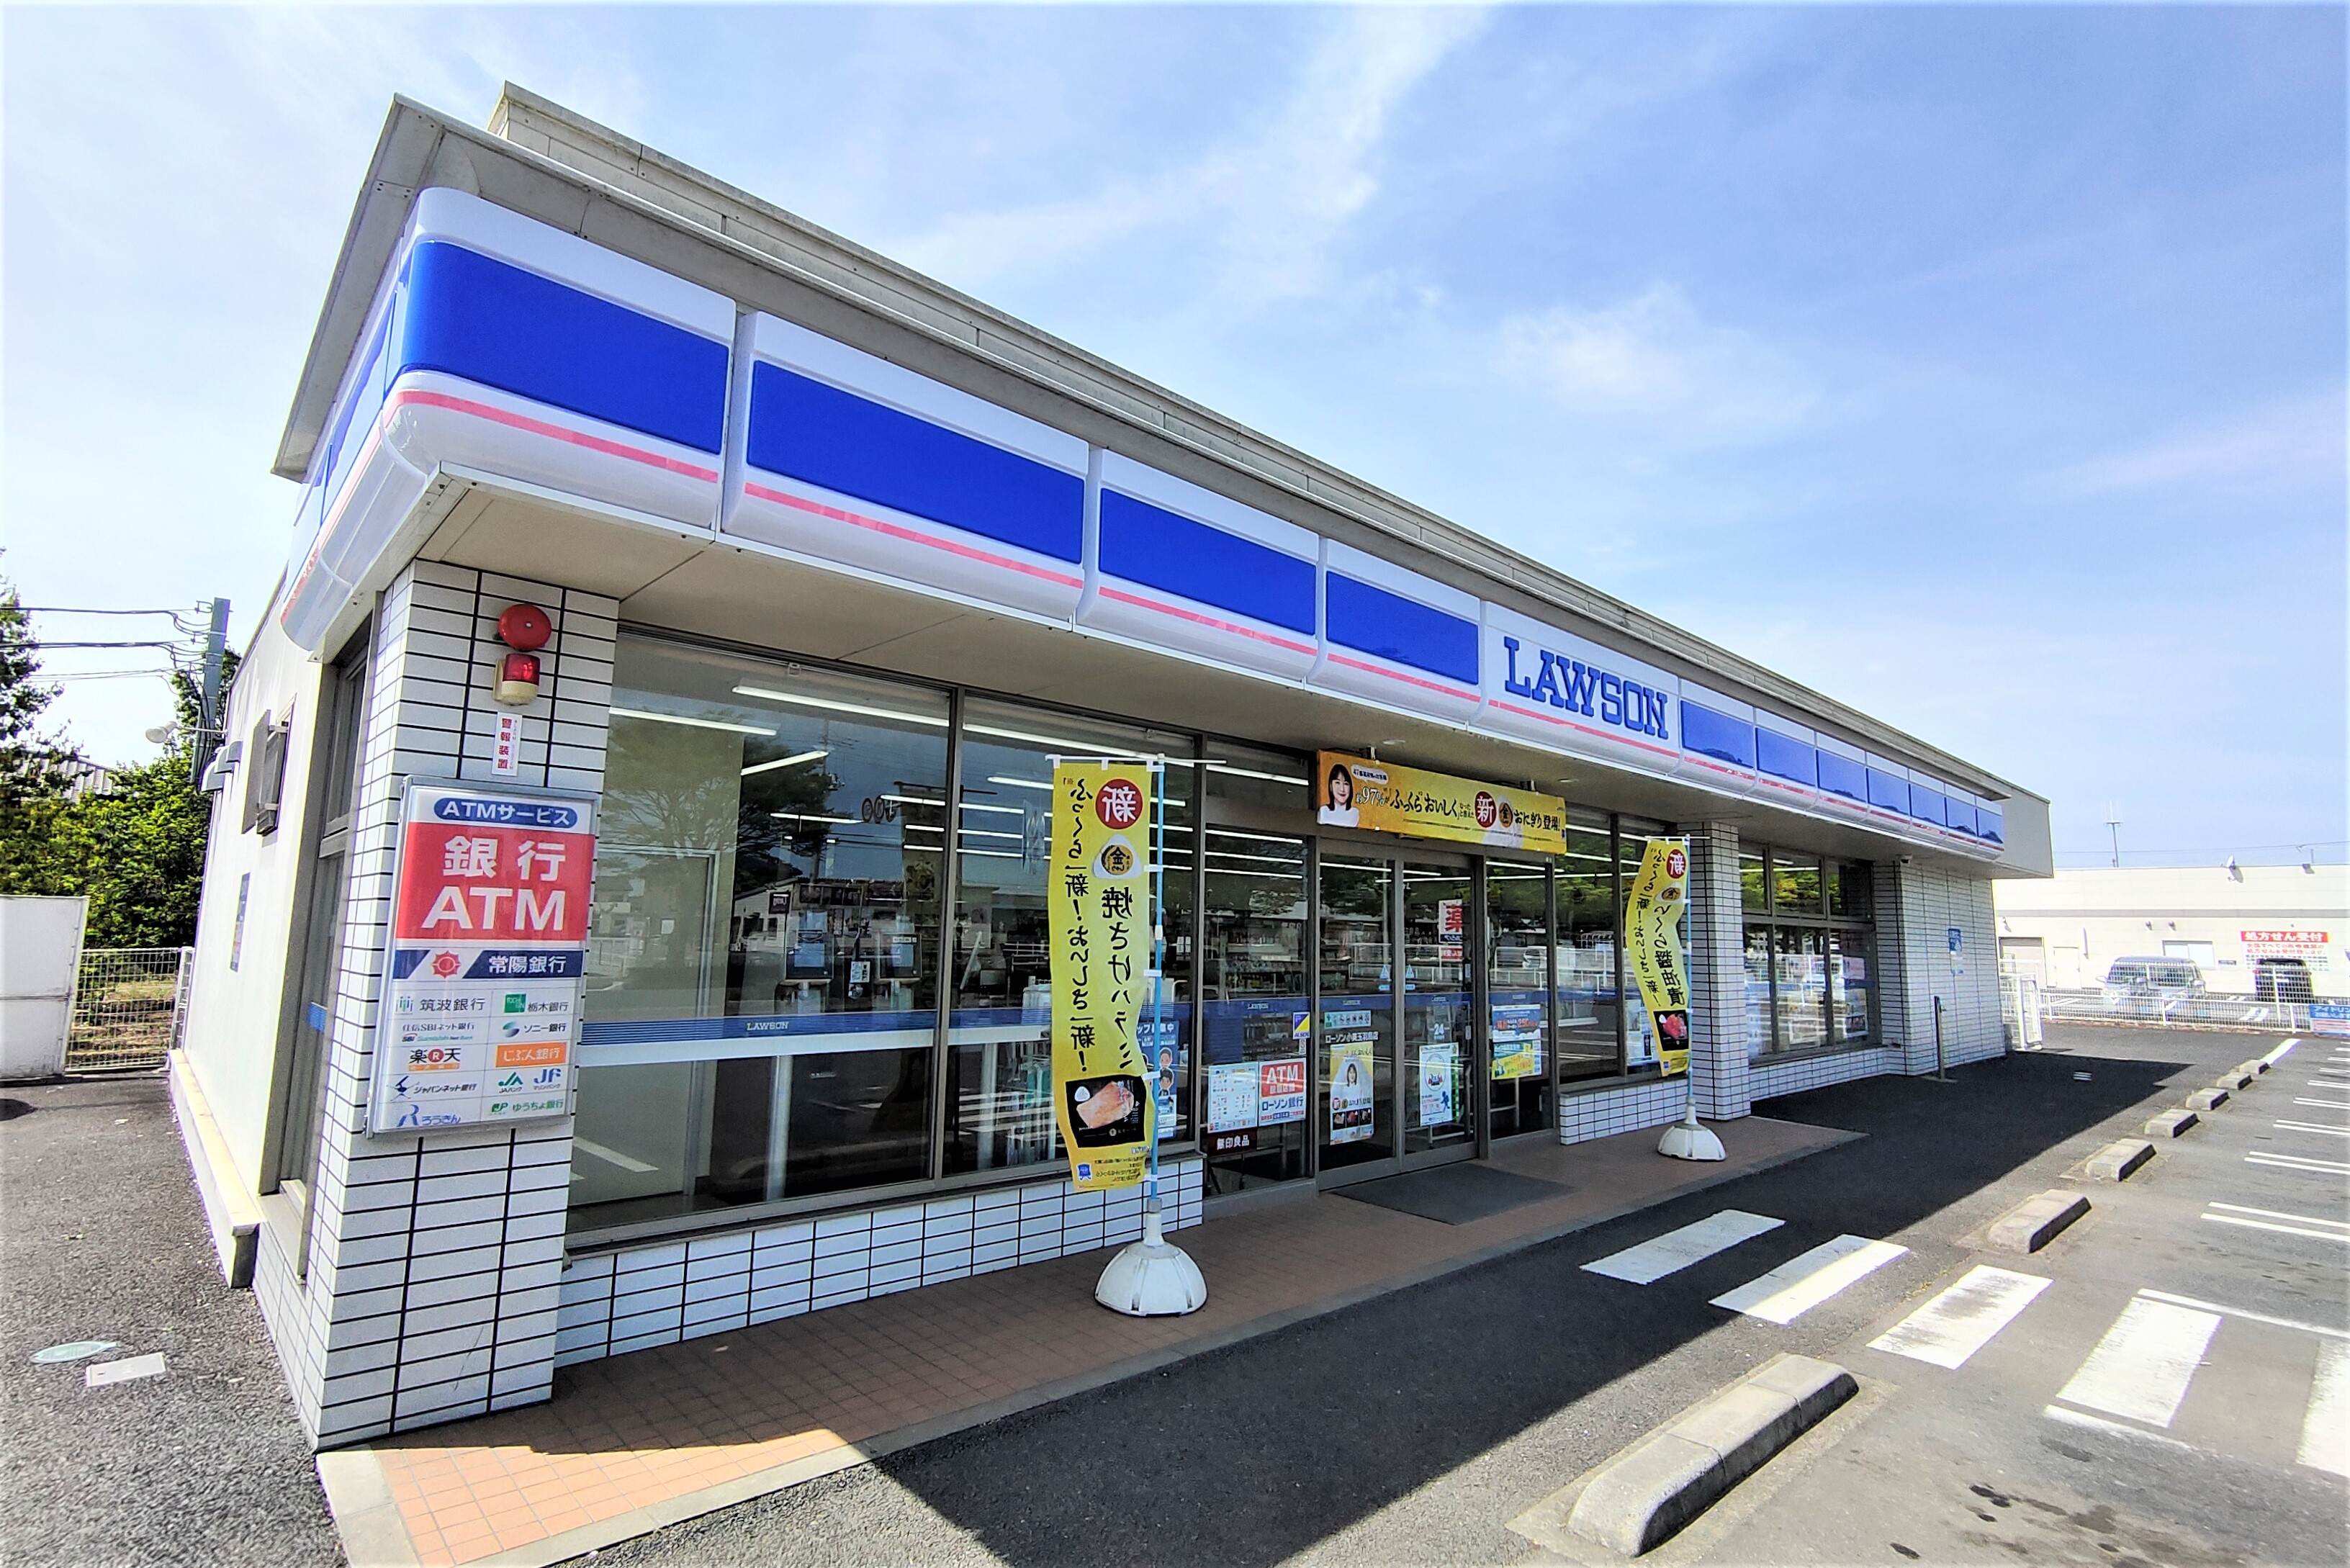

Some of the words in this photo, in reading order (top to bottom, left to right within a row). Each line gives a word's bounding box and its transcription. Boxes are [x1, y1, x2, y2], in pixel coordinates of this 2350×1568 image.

[1503, 636, 1669, 740] LAWSON
[442, 801, 570, 826] ATMサービス
[1477, 796, 1495, 824] 新
[421, 886, 566, 931] ATM
[2244, 932, 2323, 942] 処方せん受付
[488, 955, 567, 973] 常陽銀行
[419, 998, 486, 1011] 筑波銀行
[527, 1001, 569, 1012] 栃木銀行
[523, 1023, 567, 1033] ソニー銀行
[747, 1022, 789, 1031] LAWSON
[503, 1047, 560, 1062] じぶん銀行
[1266, 1065, 1298, 1084] ATM
[413, 1083, 477, 1094] ジャパンネット銀行
[512, 1099, 564, 1112] ゆうちょ銀行
[1261, 1096, 1304, 1112] ローソン銀行
[422, 1114, 462, 1125] ろうきん
[1216, 1134, 1250, 1150] 無印良品
